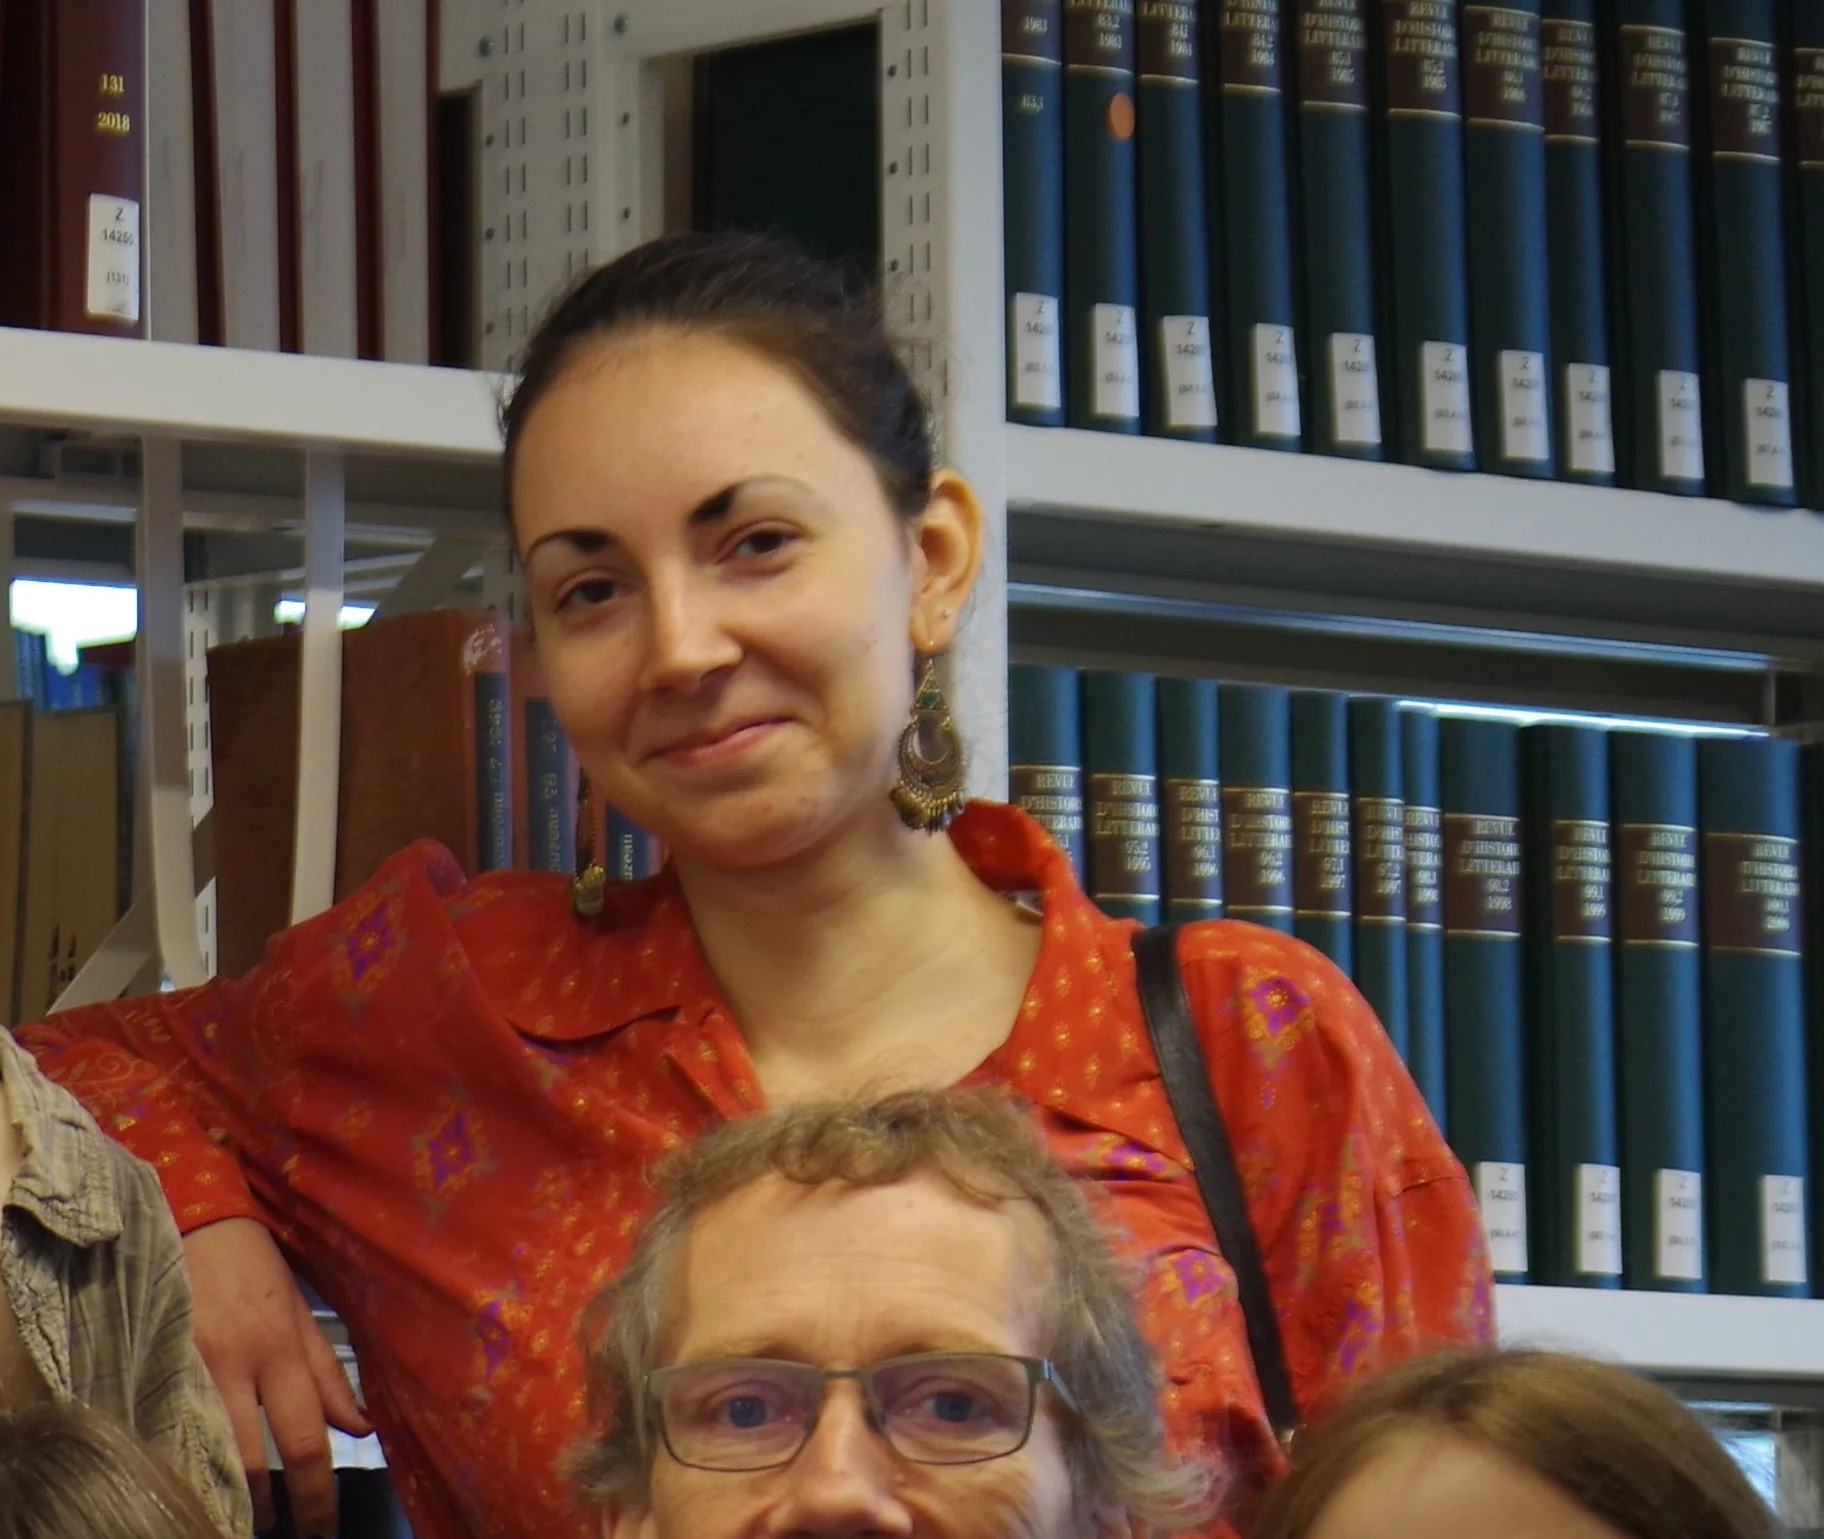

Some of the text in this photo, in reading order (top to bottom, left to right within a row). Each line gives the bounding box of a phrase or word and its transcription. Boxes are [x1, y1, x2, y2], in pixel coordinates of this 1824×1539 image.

[101, 74, 125, 94] 131
[97, 111, 131, 132] 2018
[115, 207, 124, 222] Z
[102, 228, 135, 246] 14250
